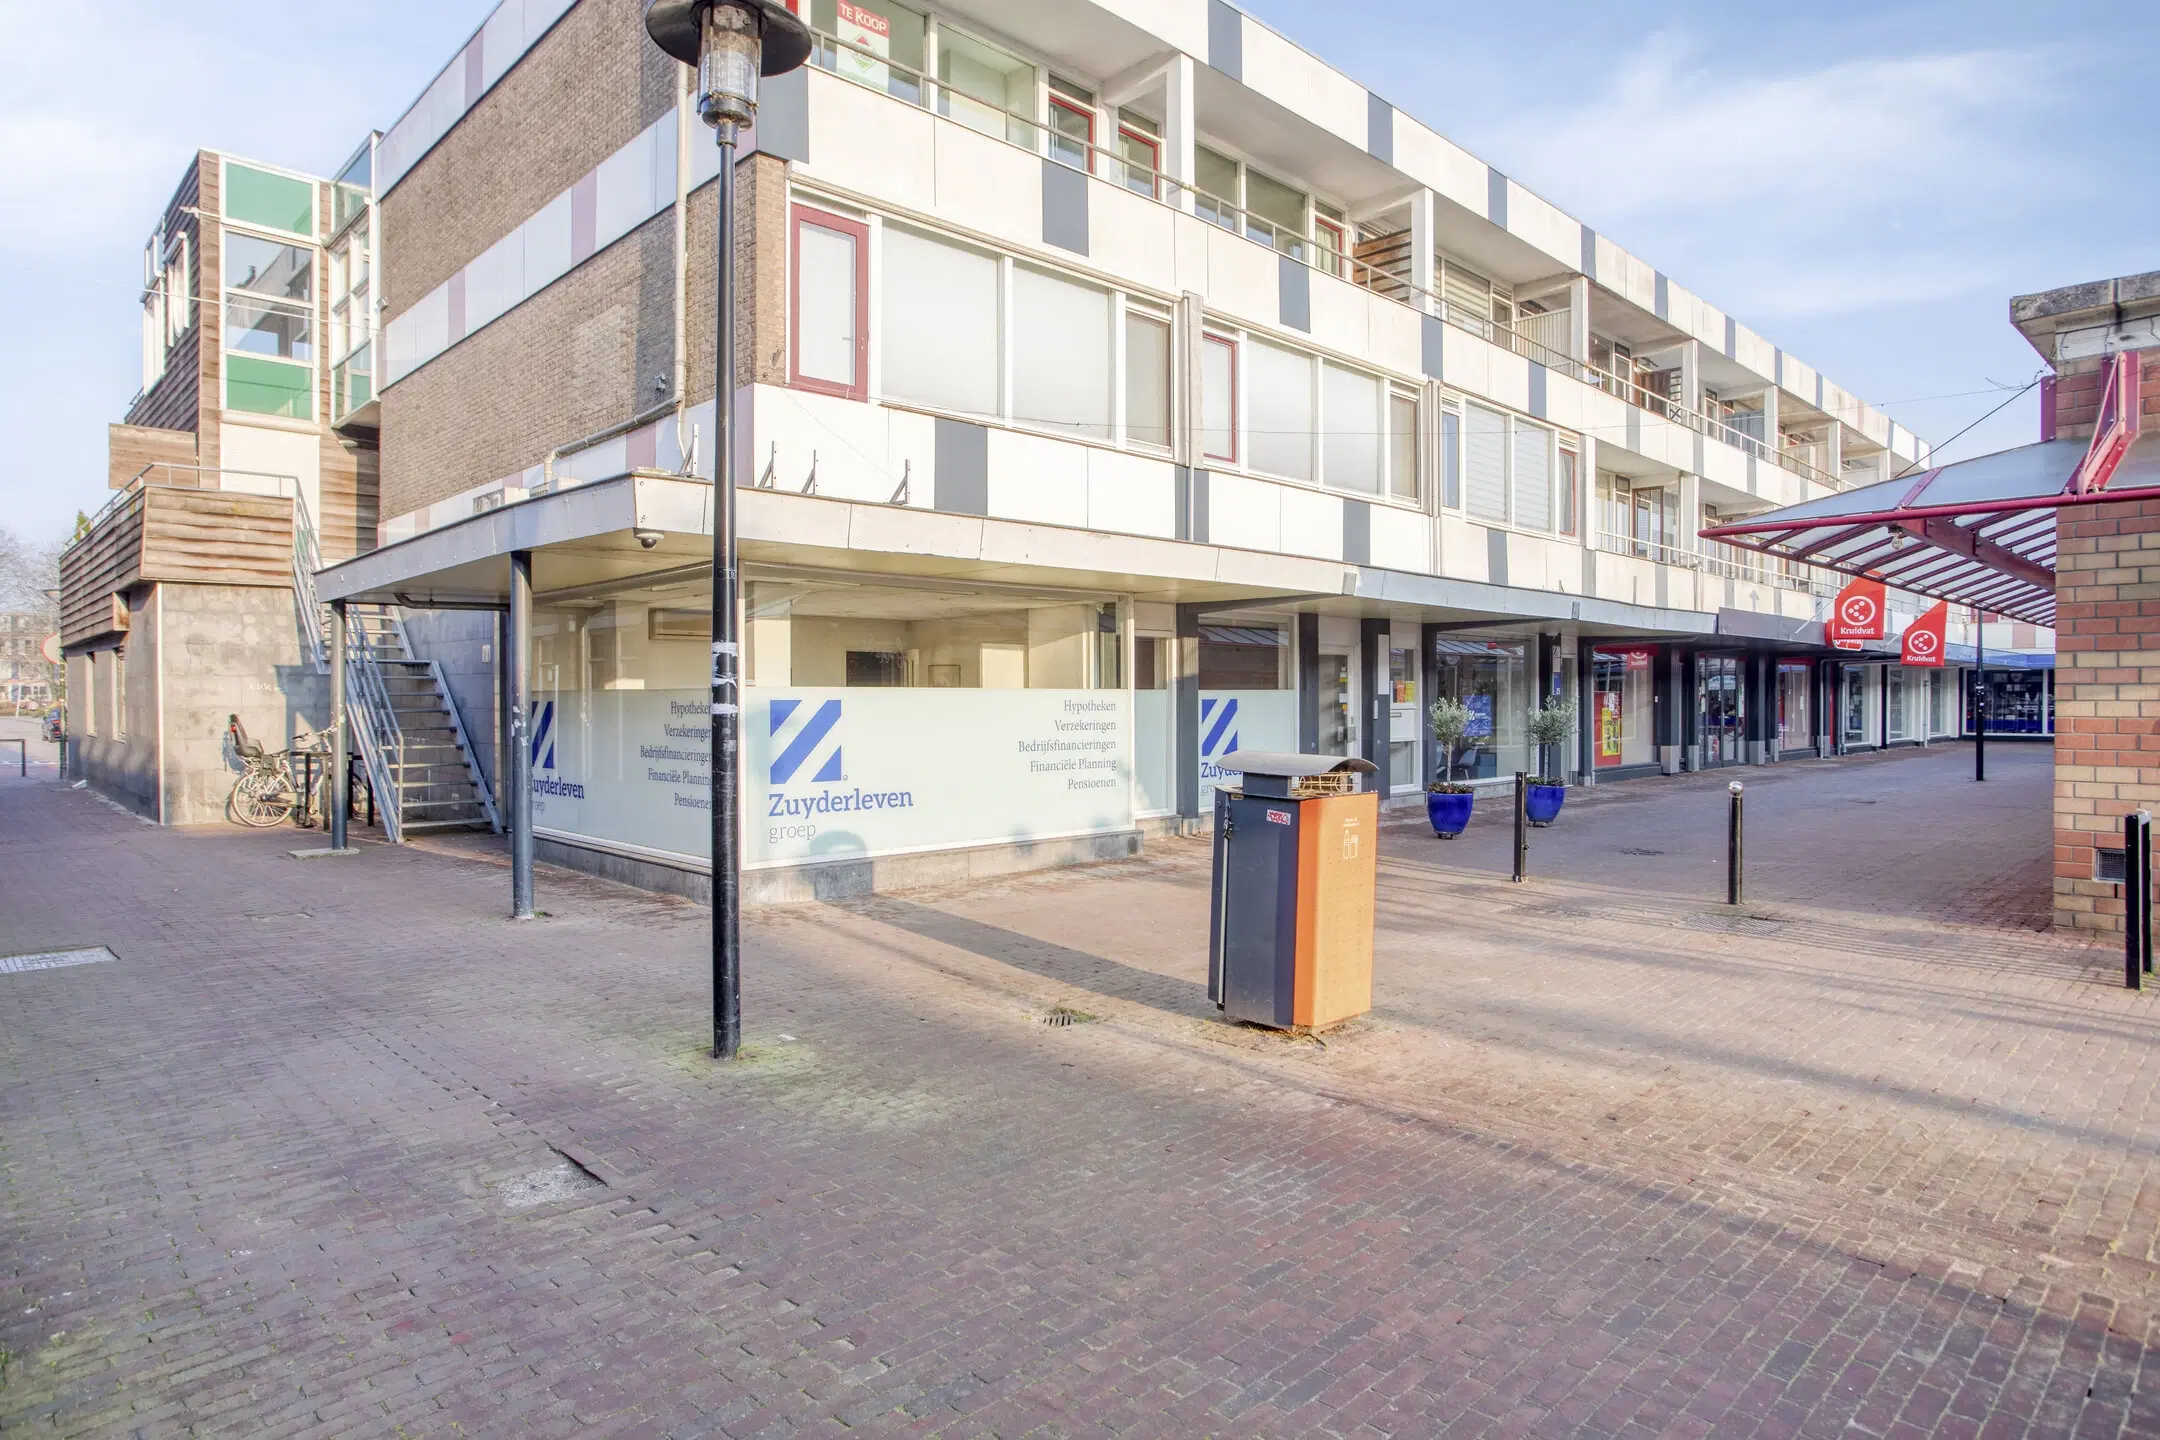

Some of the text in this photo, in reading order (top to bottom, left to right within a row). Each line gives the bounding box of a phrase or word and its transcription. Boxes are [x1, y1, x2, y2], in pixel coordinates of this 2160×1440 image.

[840, 3, 886, 31] TE KOOP
[1840, 627, 1875, 635] Kruidvat
[1064, 700, 1116, 715] Hypotheken
[1054, 720, 1116, 733] Verzekeringen
[1018, 739, 1116, 755] Bedrijfsfinancieringen
[1030, 758, 1117, 772] Financiële Planning
[1201, 762, 1243, 780] Zuy
[648, 767, 681, 783] Financiële
[532, 775, 585, 799] uyderleven
[1068, 778, 1116, 790] Pensioenen
[768, 788, 914, 819] Zuyderleven
[768, 824, 816, 844] groep
